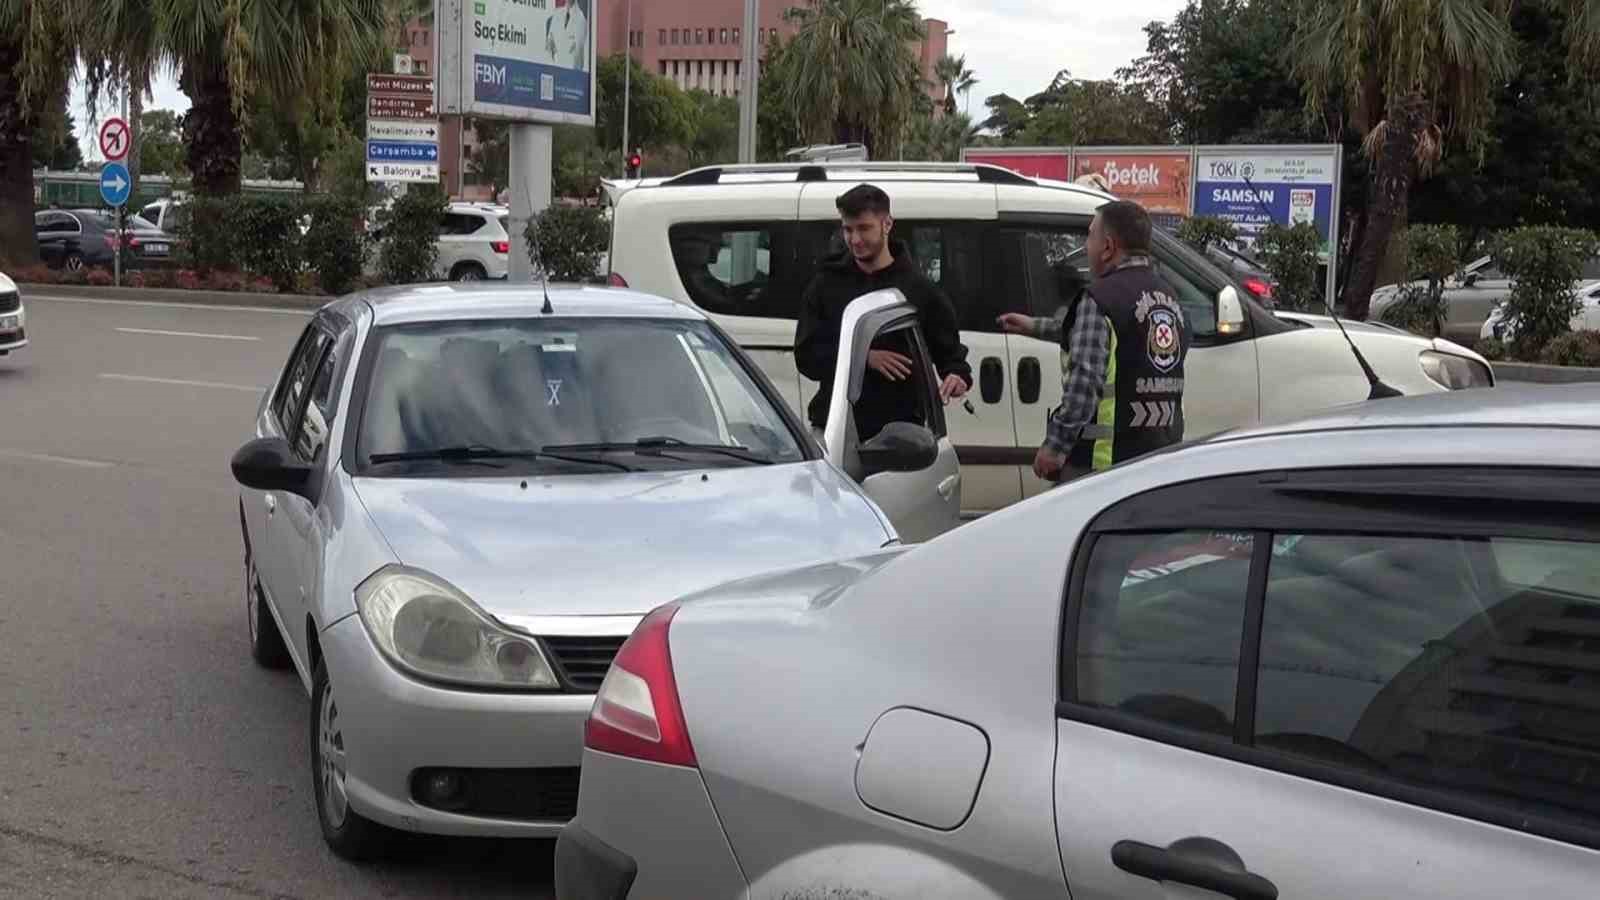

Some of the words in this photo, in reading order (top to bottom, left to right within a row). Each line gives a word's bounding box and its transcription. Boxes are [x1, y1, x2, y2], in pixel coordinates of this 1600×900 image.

[474, 21, 496, 47] Saç
[498, 24, 527, 45] Ekimi
[475, 62, 507, 85] FBM
[370, 79, 390, 88] Kent
[392, 81, 424, 90] Müzesi
[370, 98, 416, 107] Bandırma
[383, 164, 421, 177] Balonya
[1105, 160, 1160, 186] petek
[1212, 188, 1275, 203] SAMSUN
